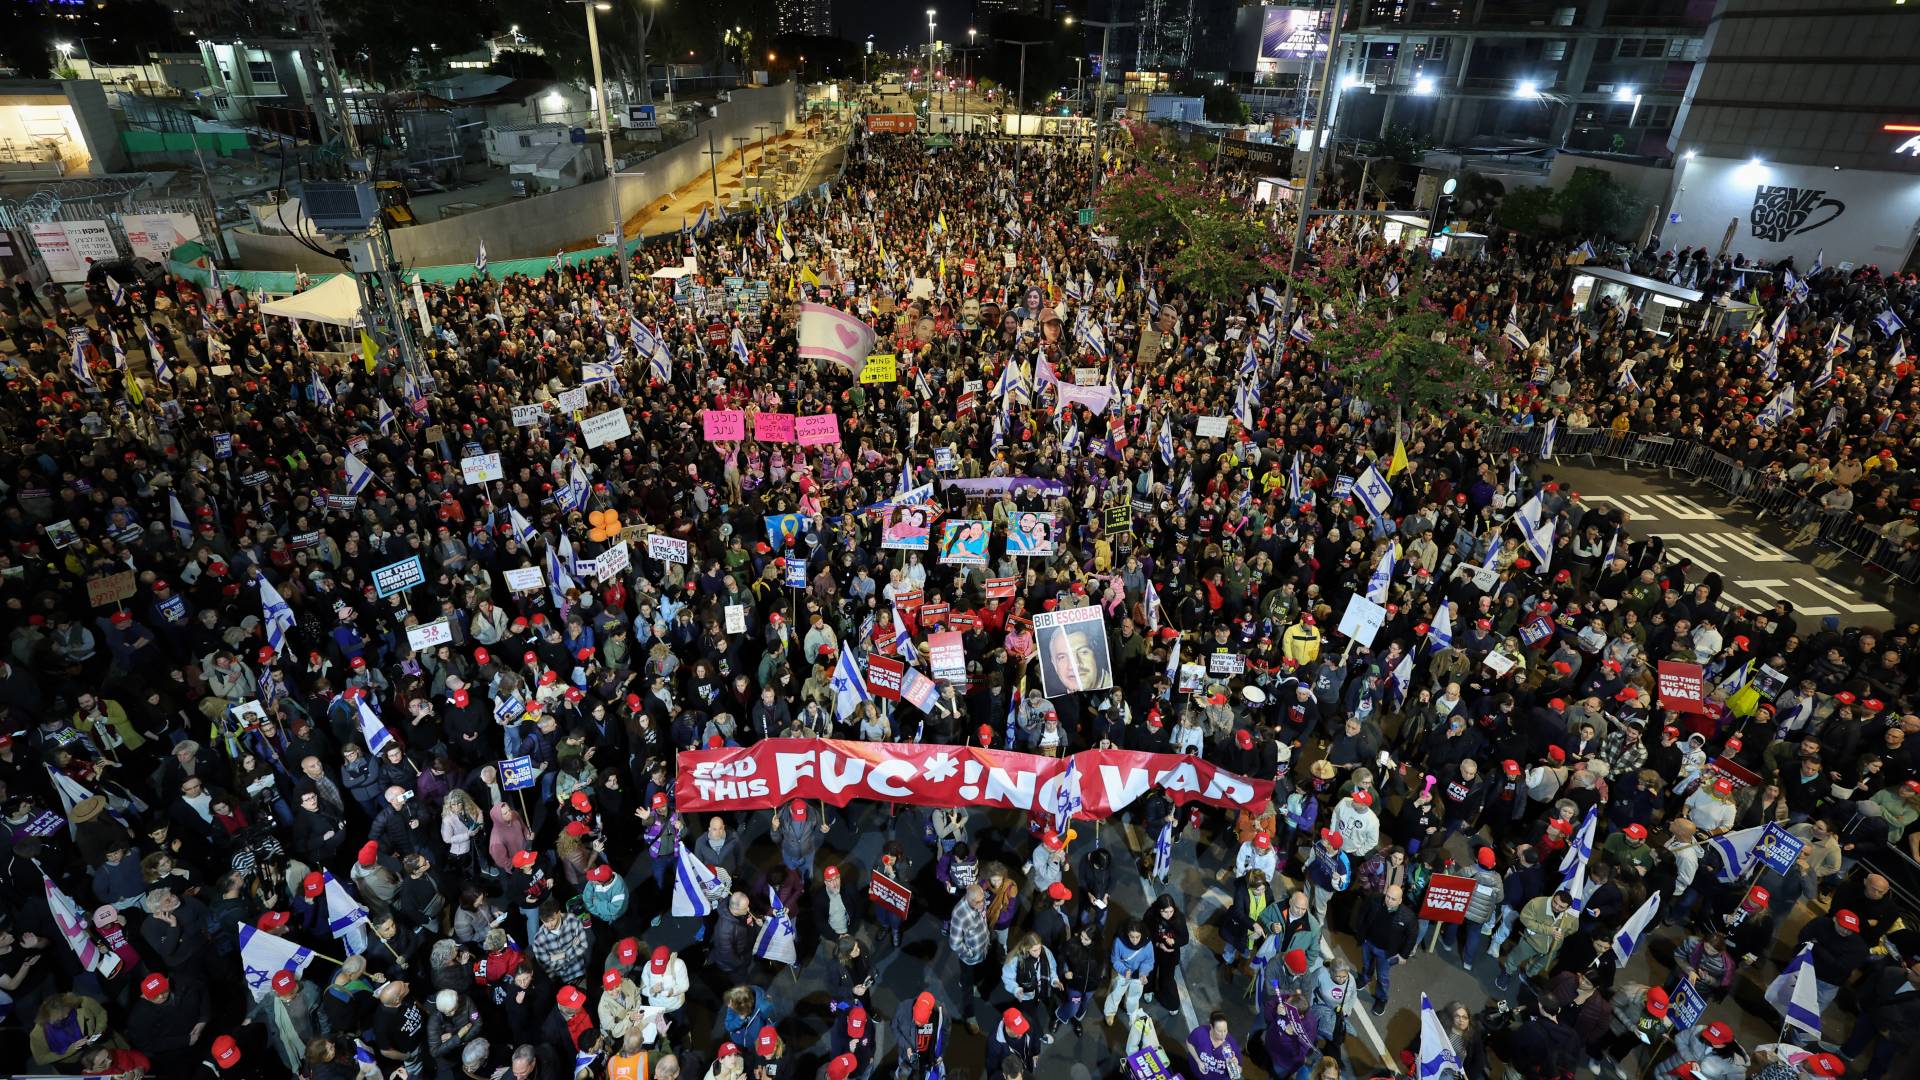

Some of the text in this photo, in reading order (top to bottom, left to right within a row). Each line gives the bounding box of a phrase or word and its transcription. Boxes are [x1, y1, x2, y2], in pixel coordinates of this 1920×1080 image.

[1248, 150, 1273, 162] TOWER
[711, 412, 738, 424] כולנו
[713, 425, 735, 435] עינב
[765, 432, 785, 440] DEAL
[1034, 606, 1101, 628] BIBI ESCOBAR
[422, 625, 439, 639] 98
[869, 664, 901, 678] END THIS
[869, 676, 901, 692] WAR
[1660, 673, 1701, 685] END THIS
[1660, 687, 1701, 701] WAR
[693, 756, 757, 780] END
[693, 778, 770, 801] THIS
[1449, 782, 1469, 798] FCK
[1429, 886, 1471, 897] END THIS
[1426, 898, 1466, 912] WAR
